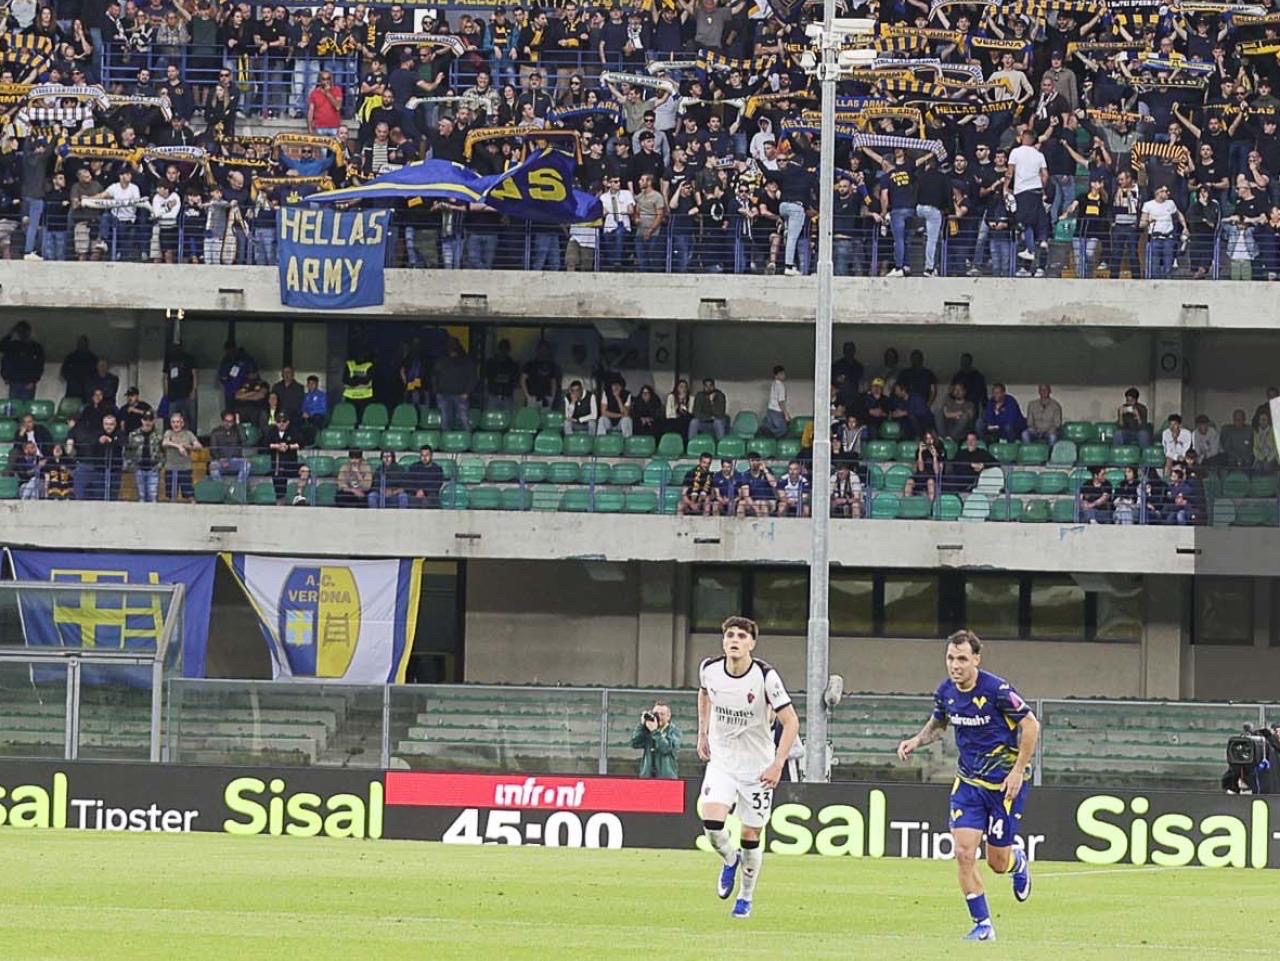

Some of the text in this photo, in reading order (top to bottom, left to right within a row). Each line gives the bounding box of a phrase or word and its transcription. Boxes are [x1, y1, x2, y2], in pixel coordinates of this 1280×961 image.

[974, 38, 1023, 48] VERONA
[552, 103, 594, 116] HELLAS
[935, 100, 1014, 115] HELLAS ARMY
[280, 208, 387, 246] HELLAS
[285, 257, 364, 295] ARMY
[288, 588, 352, 604] VERONA
[306, 573, 336, 587] A.C.
[71, 797, 199, 833] Tipster
[223, 777, 383, 839] Sisal
[751, 790, 772, 811] 33
[442, 808, 624, 850] 45:00
[696, 790, 886, 859] sal
[1075, 794, 1268, 870] Sisal
